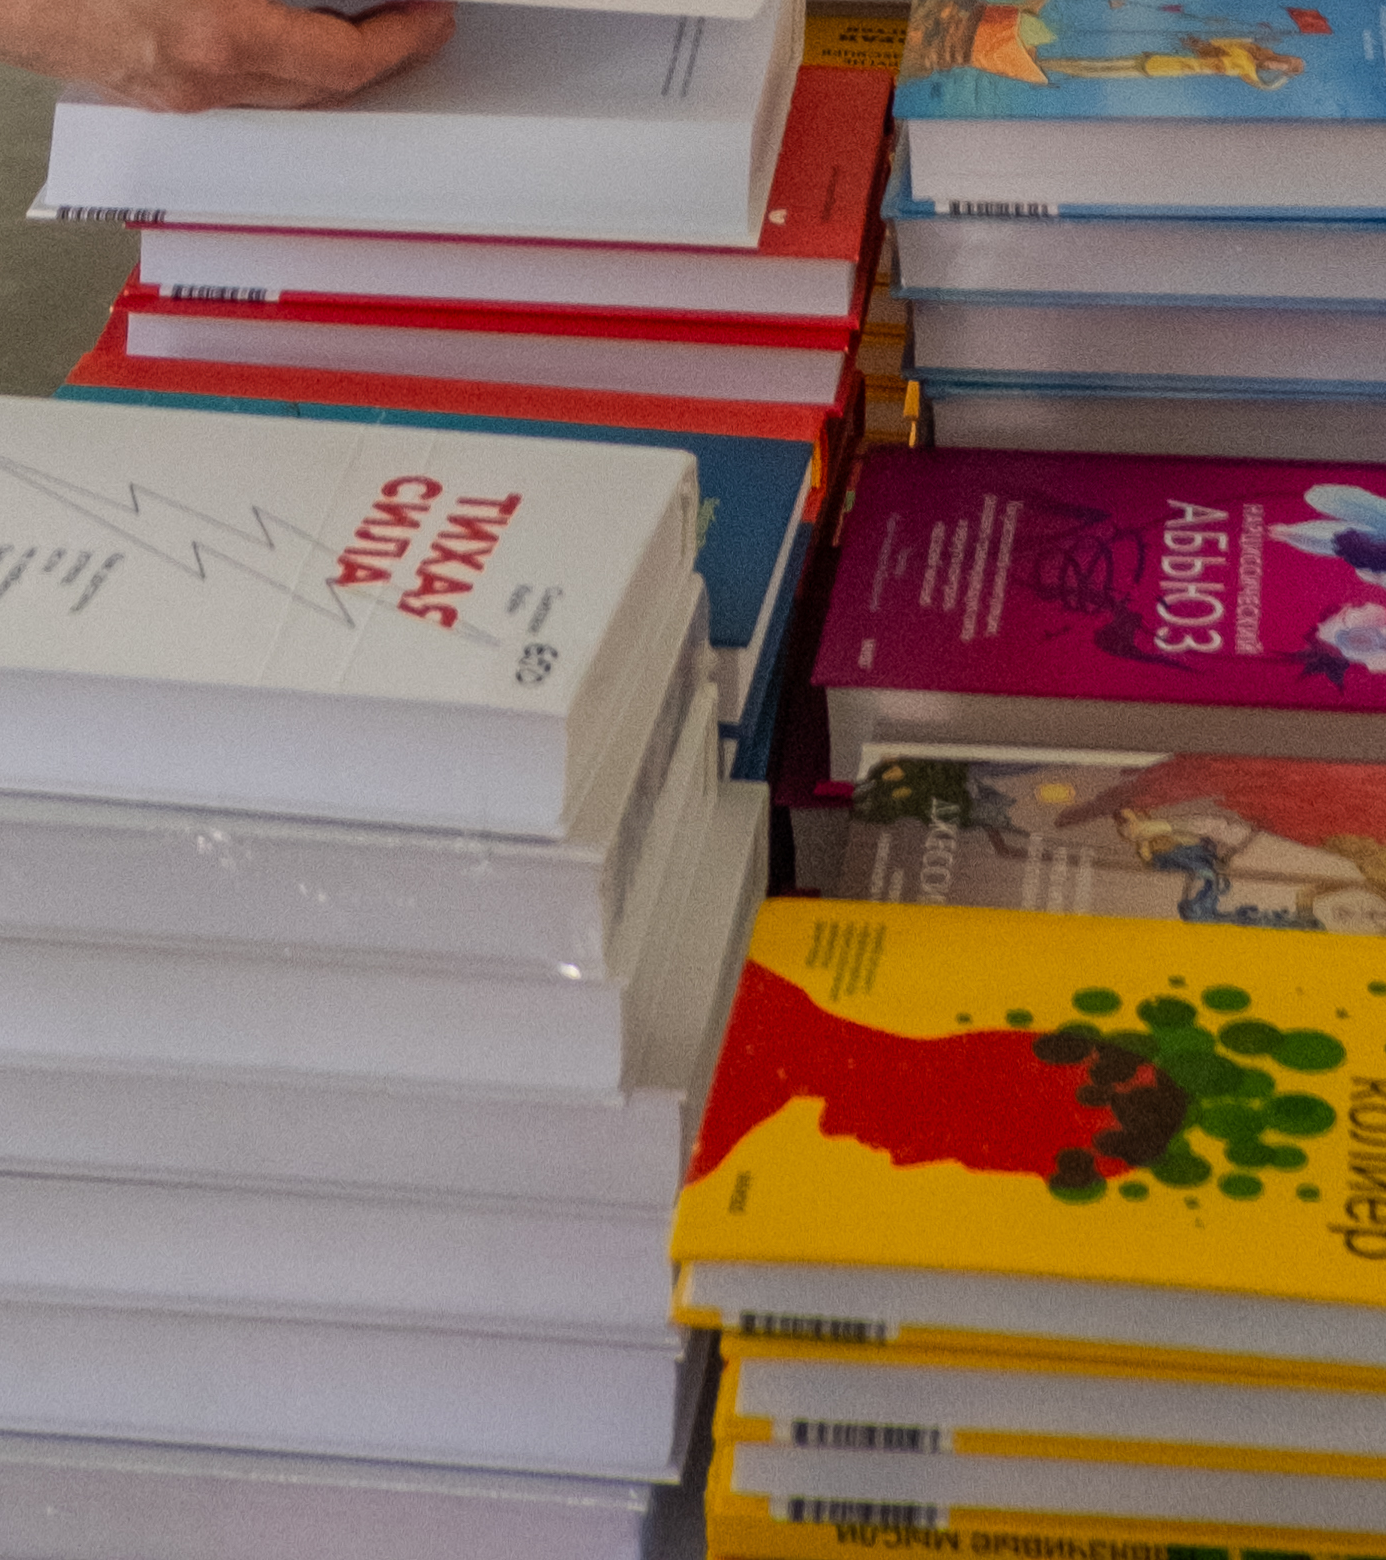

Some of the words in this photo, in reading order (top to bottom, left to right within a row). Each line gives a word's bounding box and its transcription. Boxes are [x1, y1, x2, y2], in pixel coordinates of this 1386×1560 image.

[335, 474, 445, 587] СИЛА
[396, 491, 523, 630] ТИХАЯ
[1149, 498, 1232, 656] АБЬЮЗ
[1231, 502, 1270, 657] НАРЦИССИЧЕСКИЙ
